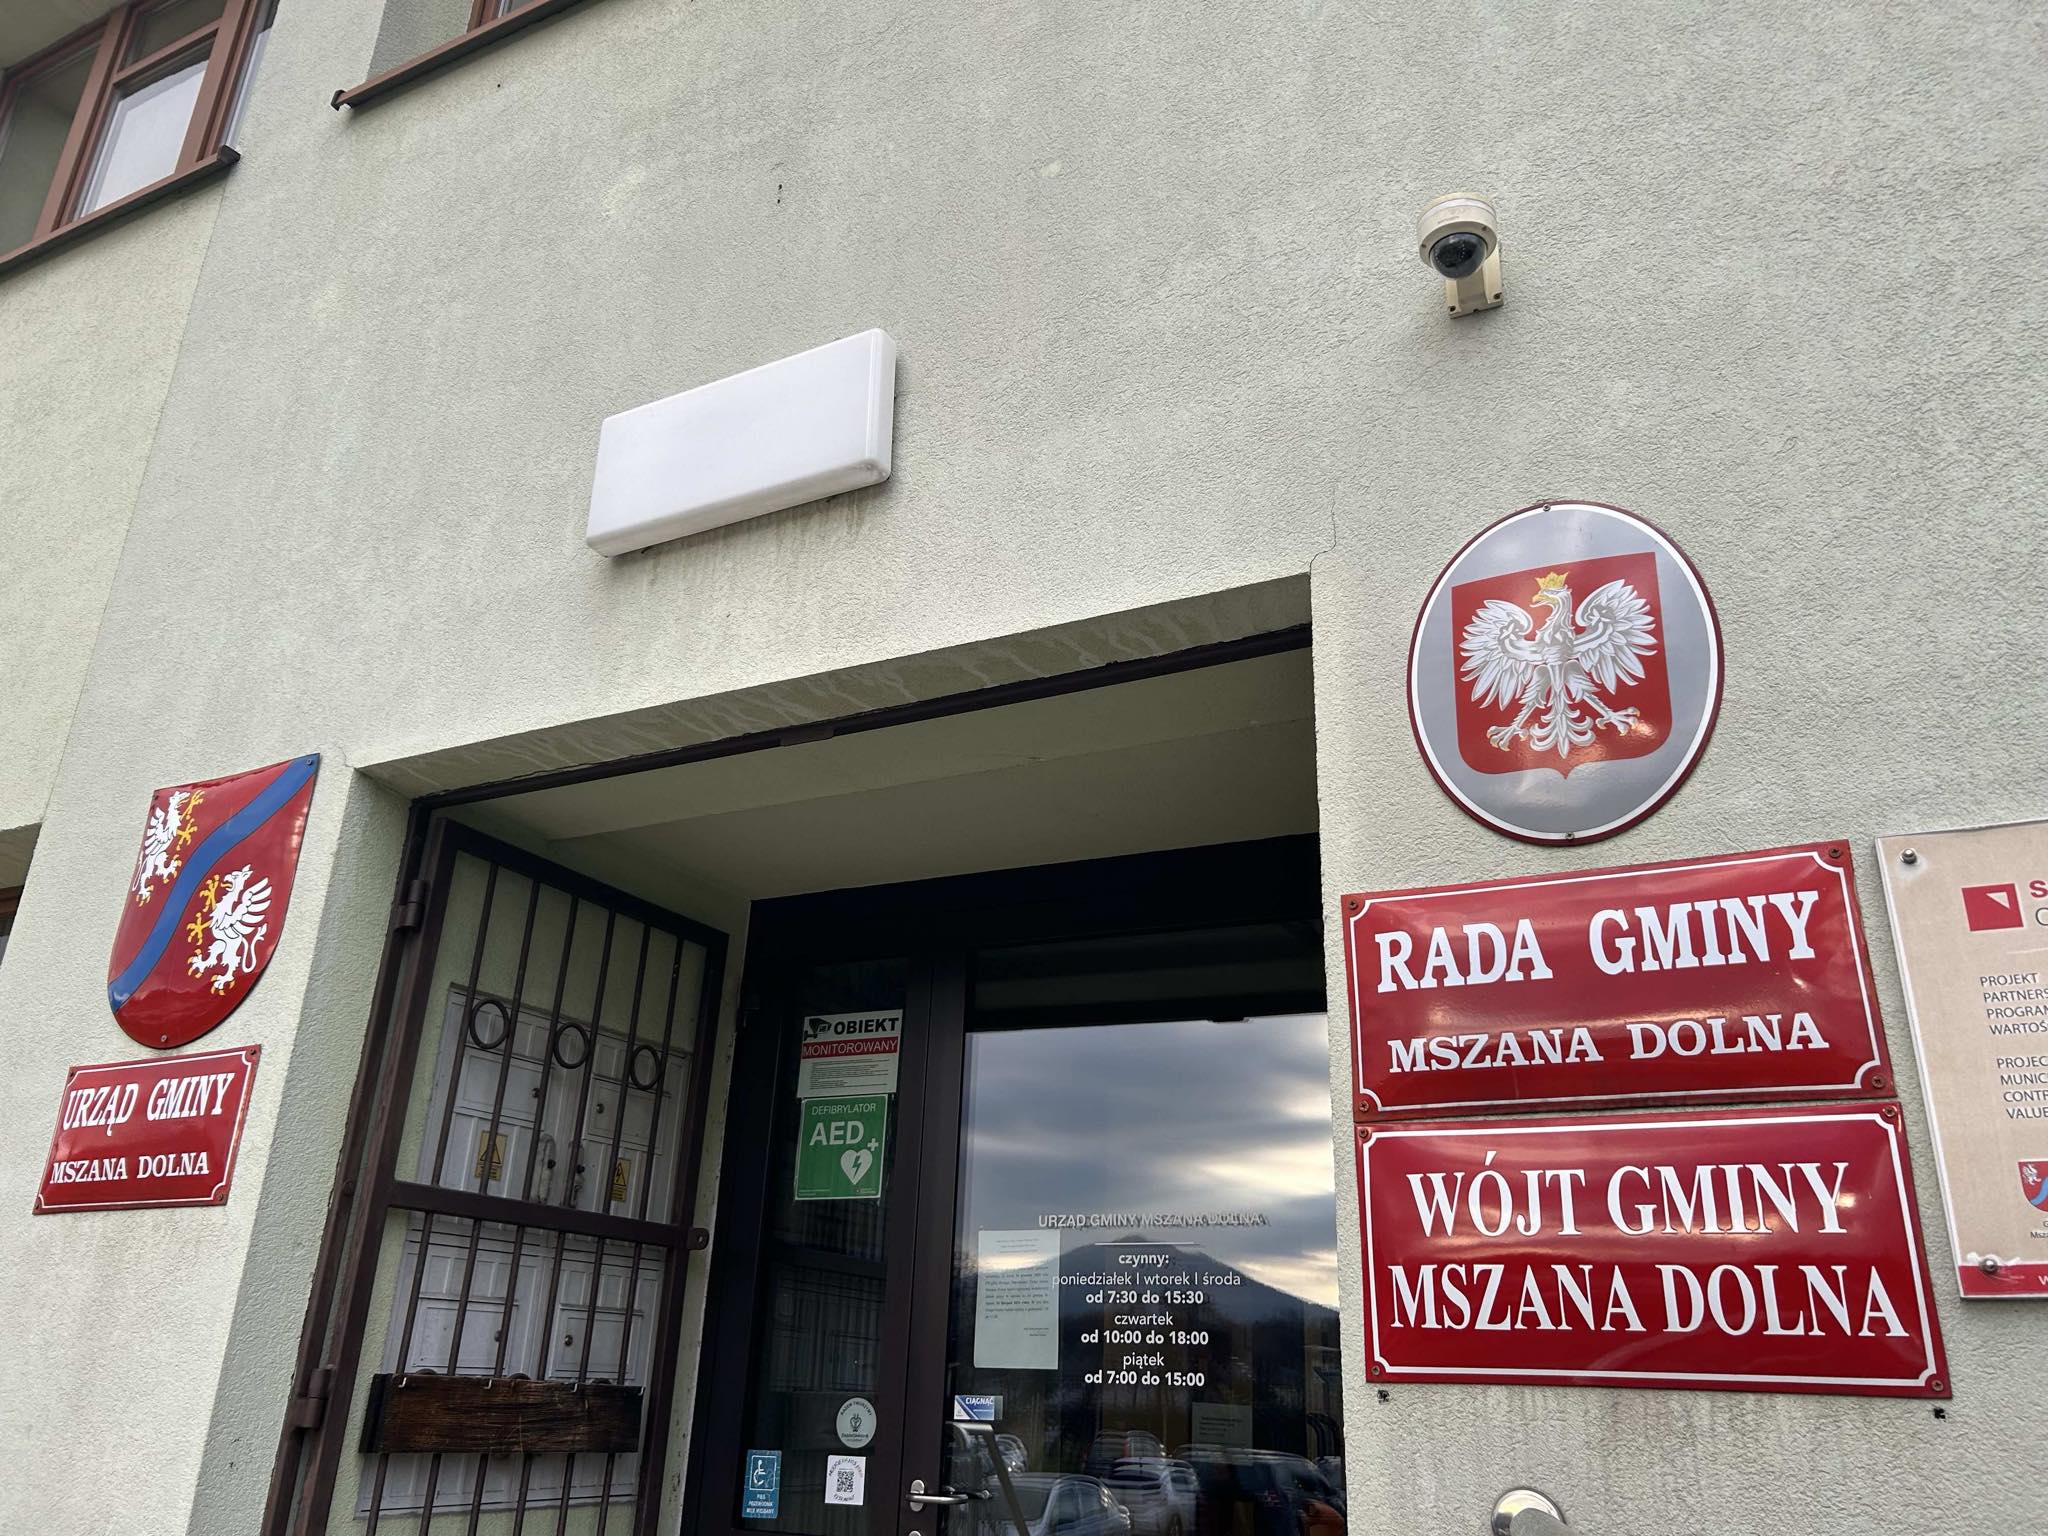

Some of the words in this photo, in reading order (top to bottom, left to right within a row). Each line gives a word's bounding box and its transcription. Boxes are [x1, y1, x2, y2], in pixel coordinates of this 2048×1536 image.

[1375, 918, 1554, 993] RADA
[1589, 891, 1819, 975] GMINY
[1980, 972, 2038, 987] PROJEKT
[834, 1018, 899, 1035] OBIEKT
[803, 1040, 897, 1057] MONITOROWANY
[1388, 1027, 1604, 1074] MSZANA
[1629, 1012, 1830, 1060] DOLNA
[63, 1083, 138, 1136] URZĄD
[147, 1072, 235, 1122] GMINY
[812, 1103, 876, 1116] DEFIBRYLATOR
[809, 1121, 864, 1146] AED
[50, 1157, 128, 1184] MSZANA
[136, 1152, 209, 1178] DOLNA
[1406, 1150, 1586, 1238] WÓJT
[1606, 1161, 1849, 1236] GMINY
[1039, 1214, 1086, 1229] URZĄD
[1089, 1214, 1137, 1228] GMINY
[1141, 1214, 1203, 1228] MSZANA
[1208, 1213, 1261, 1227] DOLNA
[1118, 1254, 1169, 1268] czynny:
[1052, 1272, 1132, 1289] poniedziałek
[1144, 1272, 1190, 1285] wtorek
[1203, 1271, 1241, 1285] środa
[1085, 1290, 1103, 1304] od
[1107, 1291, 1138, 1304] 7:30
[1141, 1290, 1160, 1304] do
[1164, 1291, 1204, 1304] 15:30
[1387, 1263, 1644, 1331] MSZANA
[1655, 1264, 1910, 1337] DOLNA
[1114, 1311, 1174, 1326] czwartek
[1080, 1330, 1099, 1343] od
[1103, 1330, 1142, 1344] 10:00
[1145, 1331, 1164, 1344] do
[1169, 1331, 1209, 1345] 18:00
[1123, 1352, 1165, 1369] piątek
[1084, 1370, 1103, 1384] od
[1106, 1371, 1137, 1384] 7:00
[1141, 1372, 1160, 1386] do
[1165, 1372, 1205, 1386] 15:00
